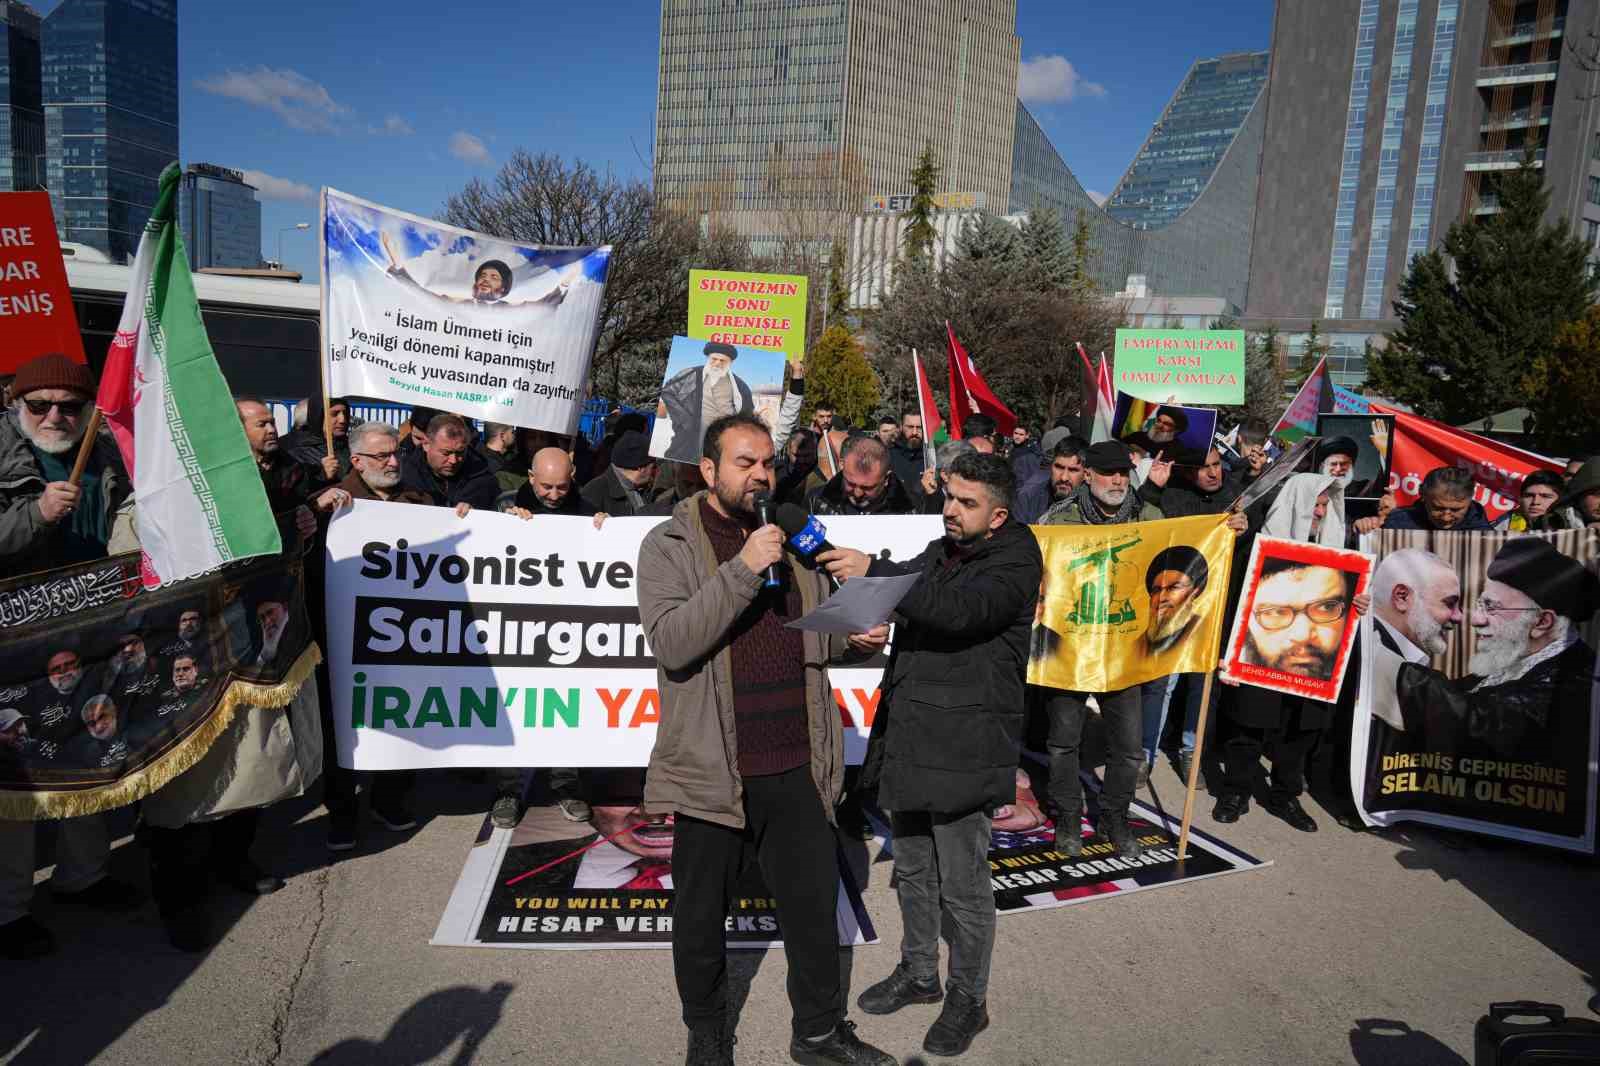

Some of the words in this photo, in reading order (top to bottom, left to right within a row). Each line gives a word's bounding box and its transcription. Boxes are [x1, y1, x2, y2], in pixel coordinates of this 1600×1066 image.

[0, 227, 35, 247] RE
[726, 298, 771, 311] SONU
[396, 308, 438, 333] İslam
[443, 316, 502, 342] Ümmeti
[507, 329, 533, 348] için
[710, 332, 783, 347] GELECEK
[403, 337, 459, 359] dönemi
[464, 347, 555, 375] kapanmıştır!
[420, 365, 507, 389] yuvasından
[512, 376, 530, 392] da
[360, 538, 565, 589] Siyonist
[577, 560, 634, 589] ve
[1382, 752, 1453, 774] DİRENİŞ
[1381, 772, 1466, 799] SELAM
[1474, 780, 1566, 815] OLSUN
[514, 897, 559, 909] YOU
[567, 897, 621, 909] WILL
[629, 898, 669, 909] PAY
[497, 916, 604, 933] HESAP
